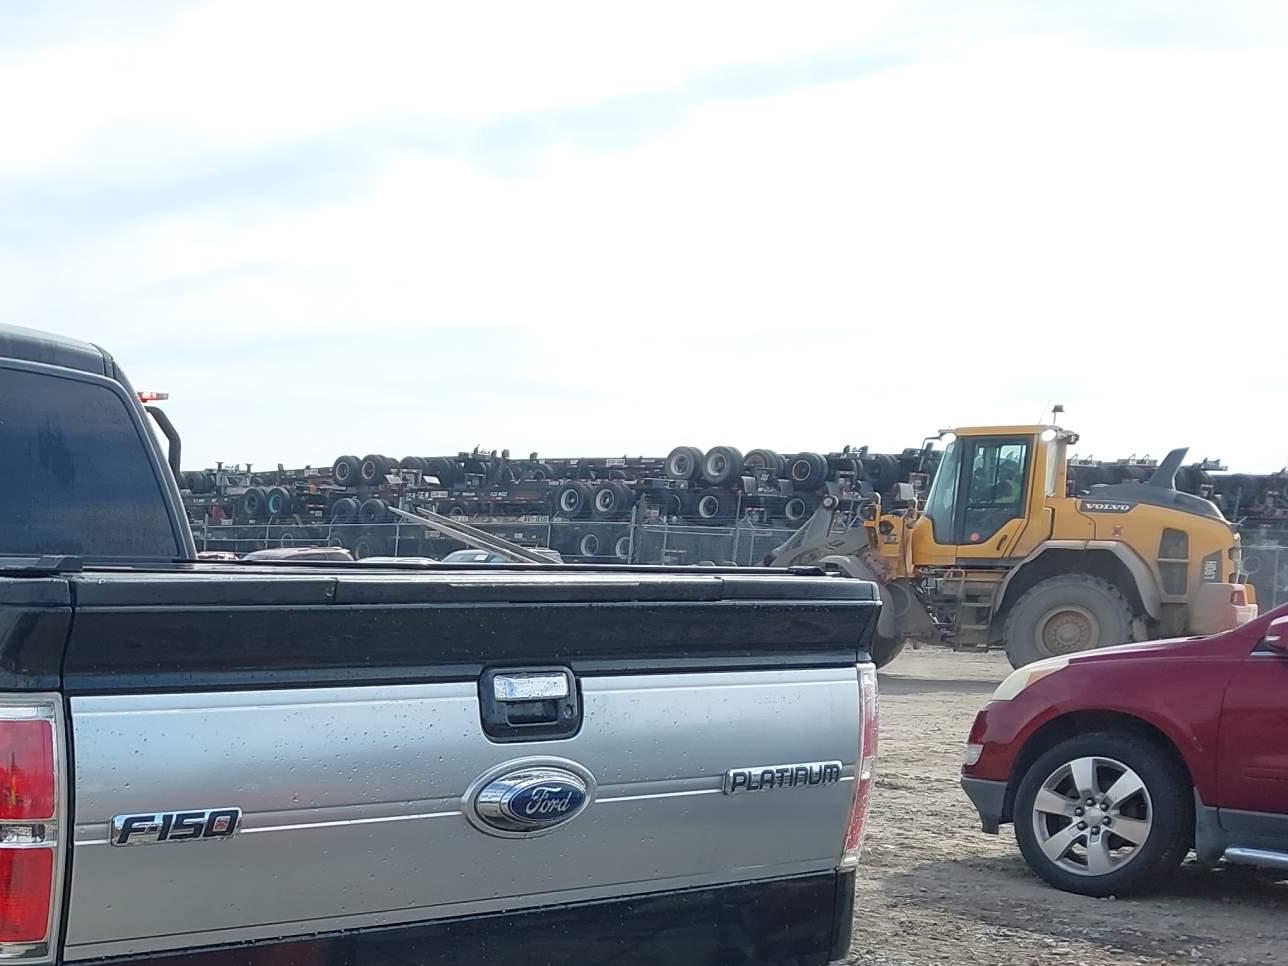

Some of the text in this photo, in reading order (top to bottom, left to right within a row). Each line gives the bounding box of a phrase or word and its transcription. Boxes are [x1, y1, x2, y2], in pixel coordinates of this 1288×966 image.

[1085, 503, 1130, 511] VOLVO
[730, 763, 841, 793] PLATINUM
[525, 786, 573, 815] Ford
